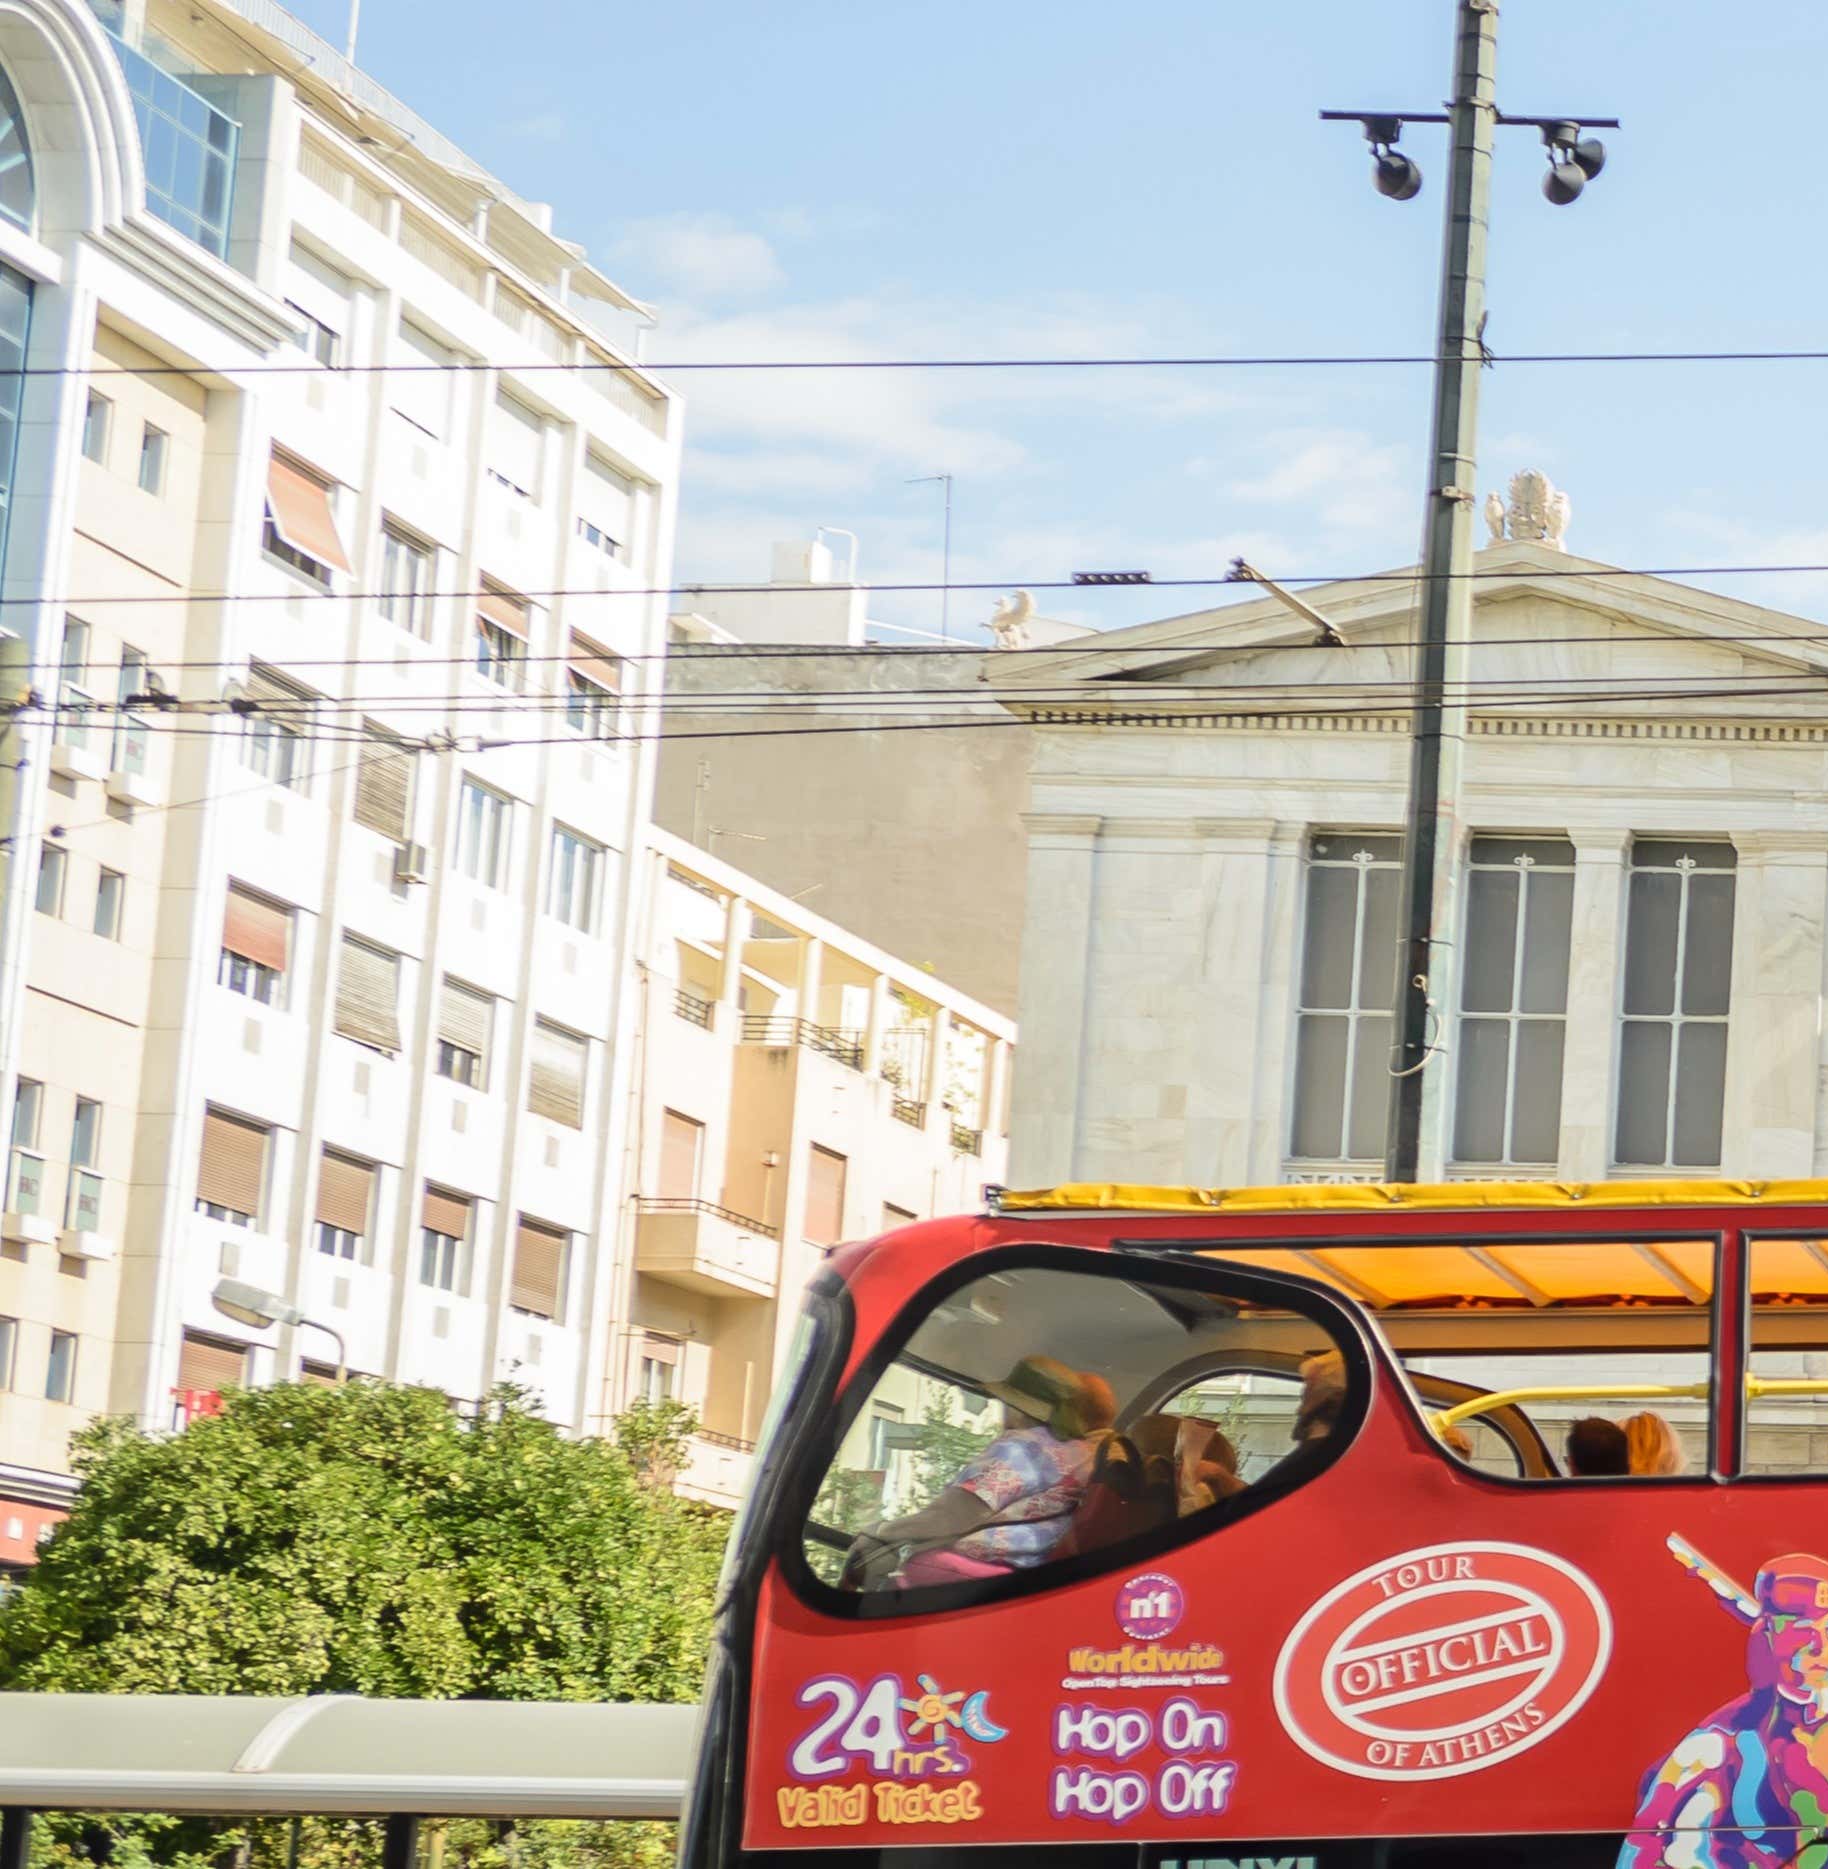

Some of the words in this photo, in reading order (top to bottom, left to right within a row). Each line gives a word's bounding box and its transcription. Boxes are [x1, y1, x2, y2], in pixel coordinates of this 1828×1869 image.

[1371, 1555, 1476, 1598] TOUR
[1068, 1644, 1225, 1674] Worldwide
[1340, 1619, 1547, 1697] OFFICIAL
[791, 1677, 905, 1775] 24
[1057, 1708, 1148, 1758] Hop
[1161, 1701, 1226, 1750] On
[1365, 1741, 1410, 1767] OF
[1417, 1701, 1546, 1767] ATHENS
[776, 1783, 869, 1829] Valid
[873, 1780, 985, 1826] Ticket
[1054, 1770, 1144, 1821] Hop
[1159, 1764, 1235, 1814] Off
